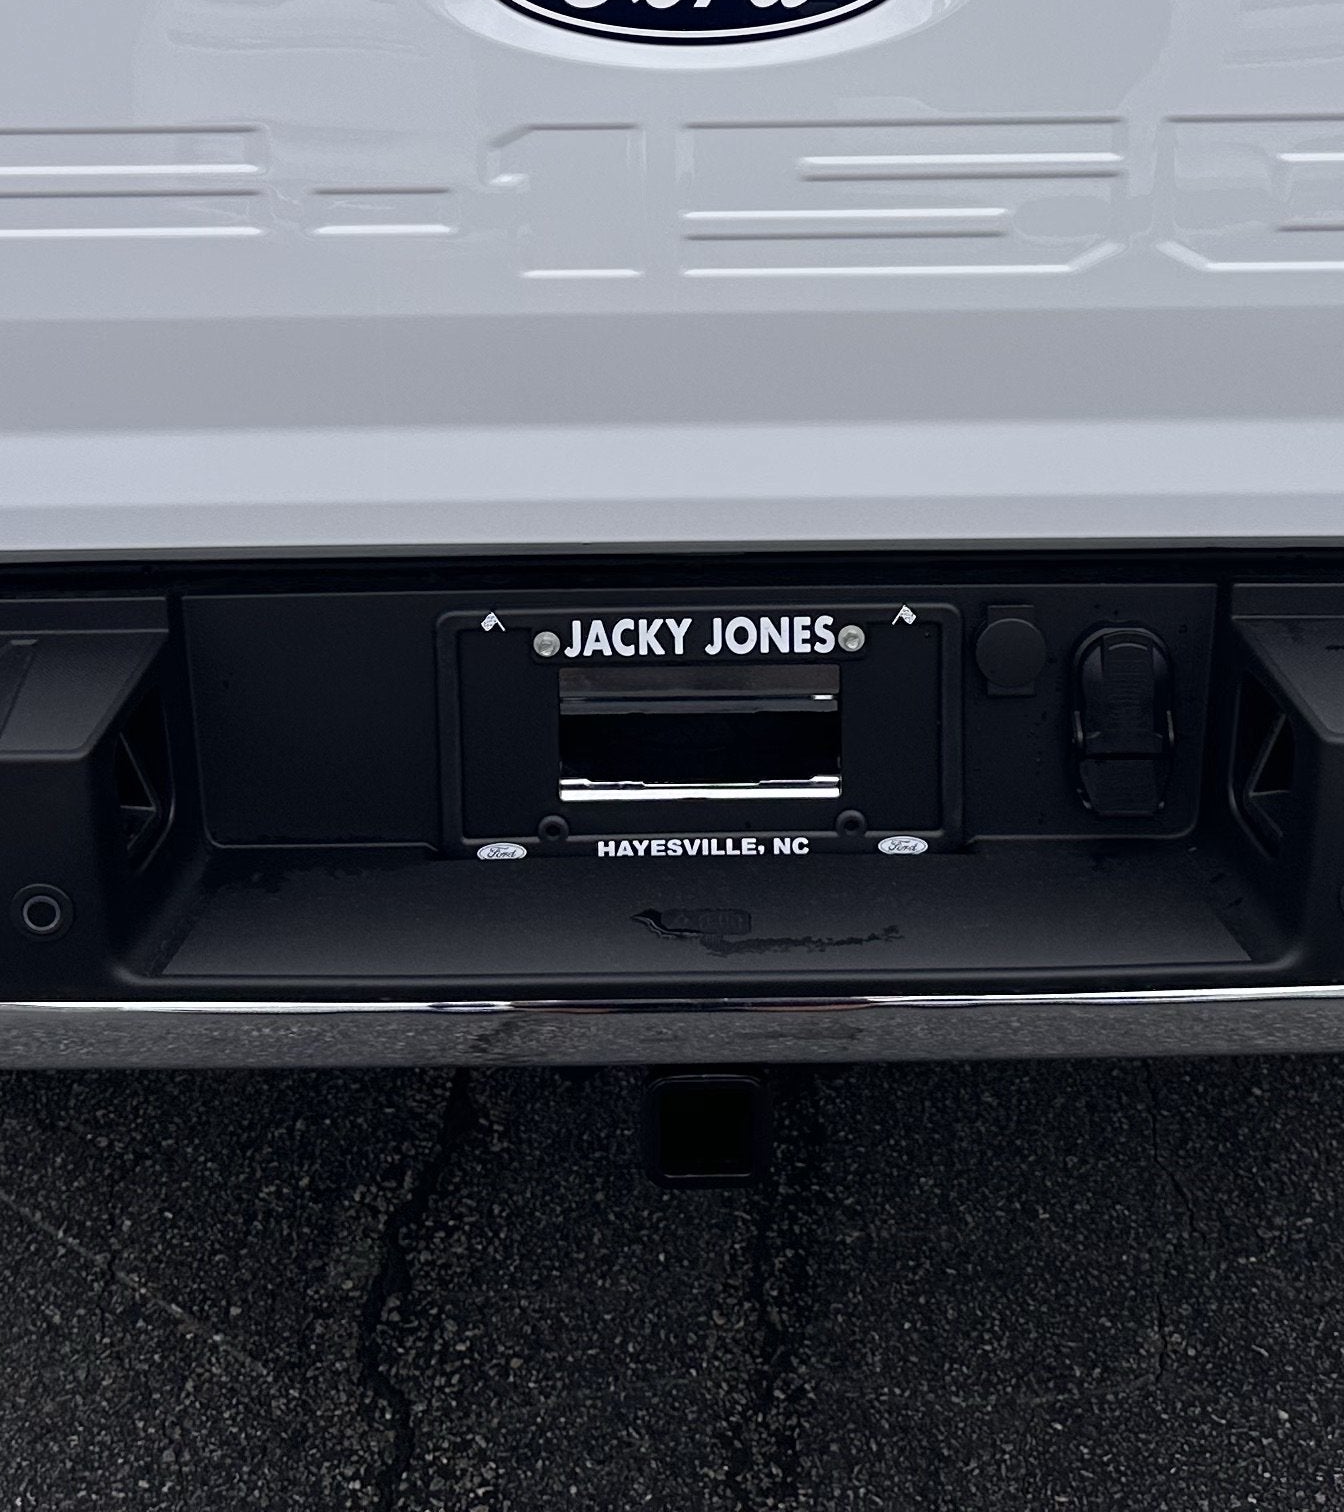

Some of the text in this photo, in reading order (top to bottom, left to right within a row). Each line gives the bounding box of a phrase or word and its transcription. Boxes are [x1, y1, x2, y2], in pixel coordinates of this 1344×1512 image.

[563, 615, 835, 657] JACKY JONES
[597, 837, 810, 857] HAYESVILLE, NC
